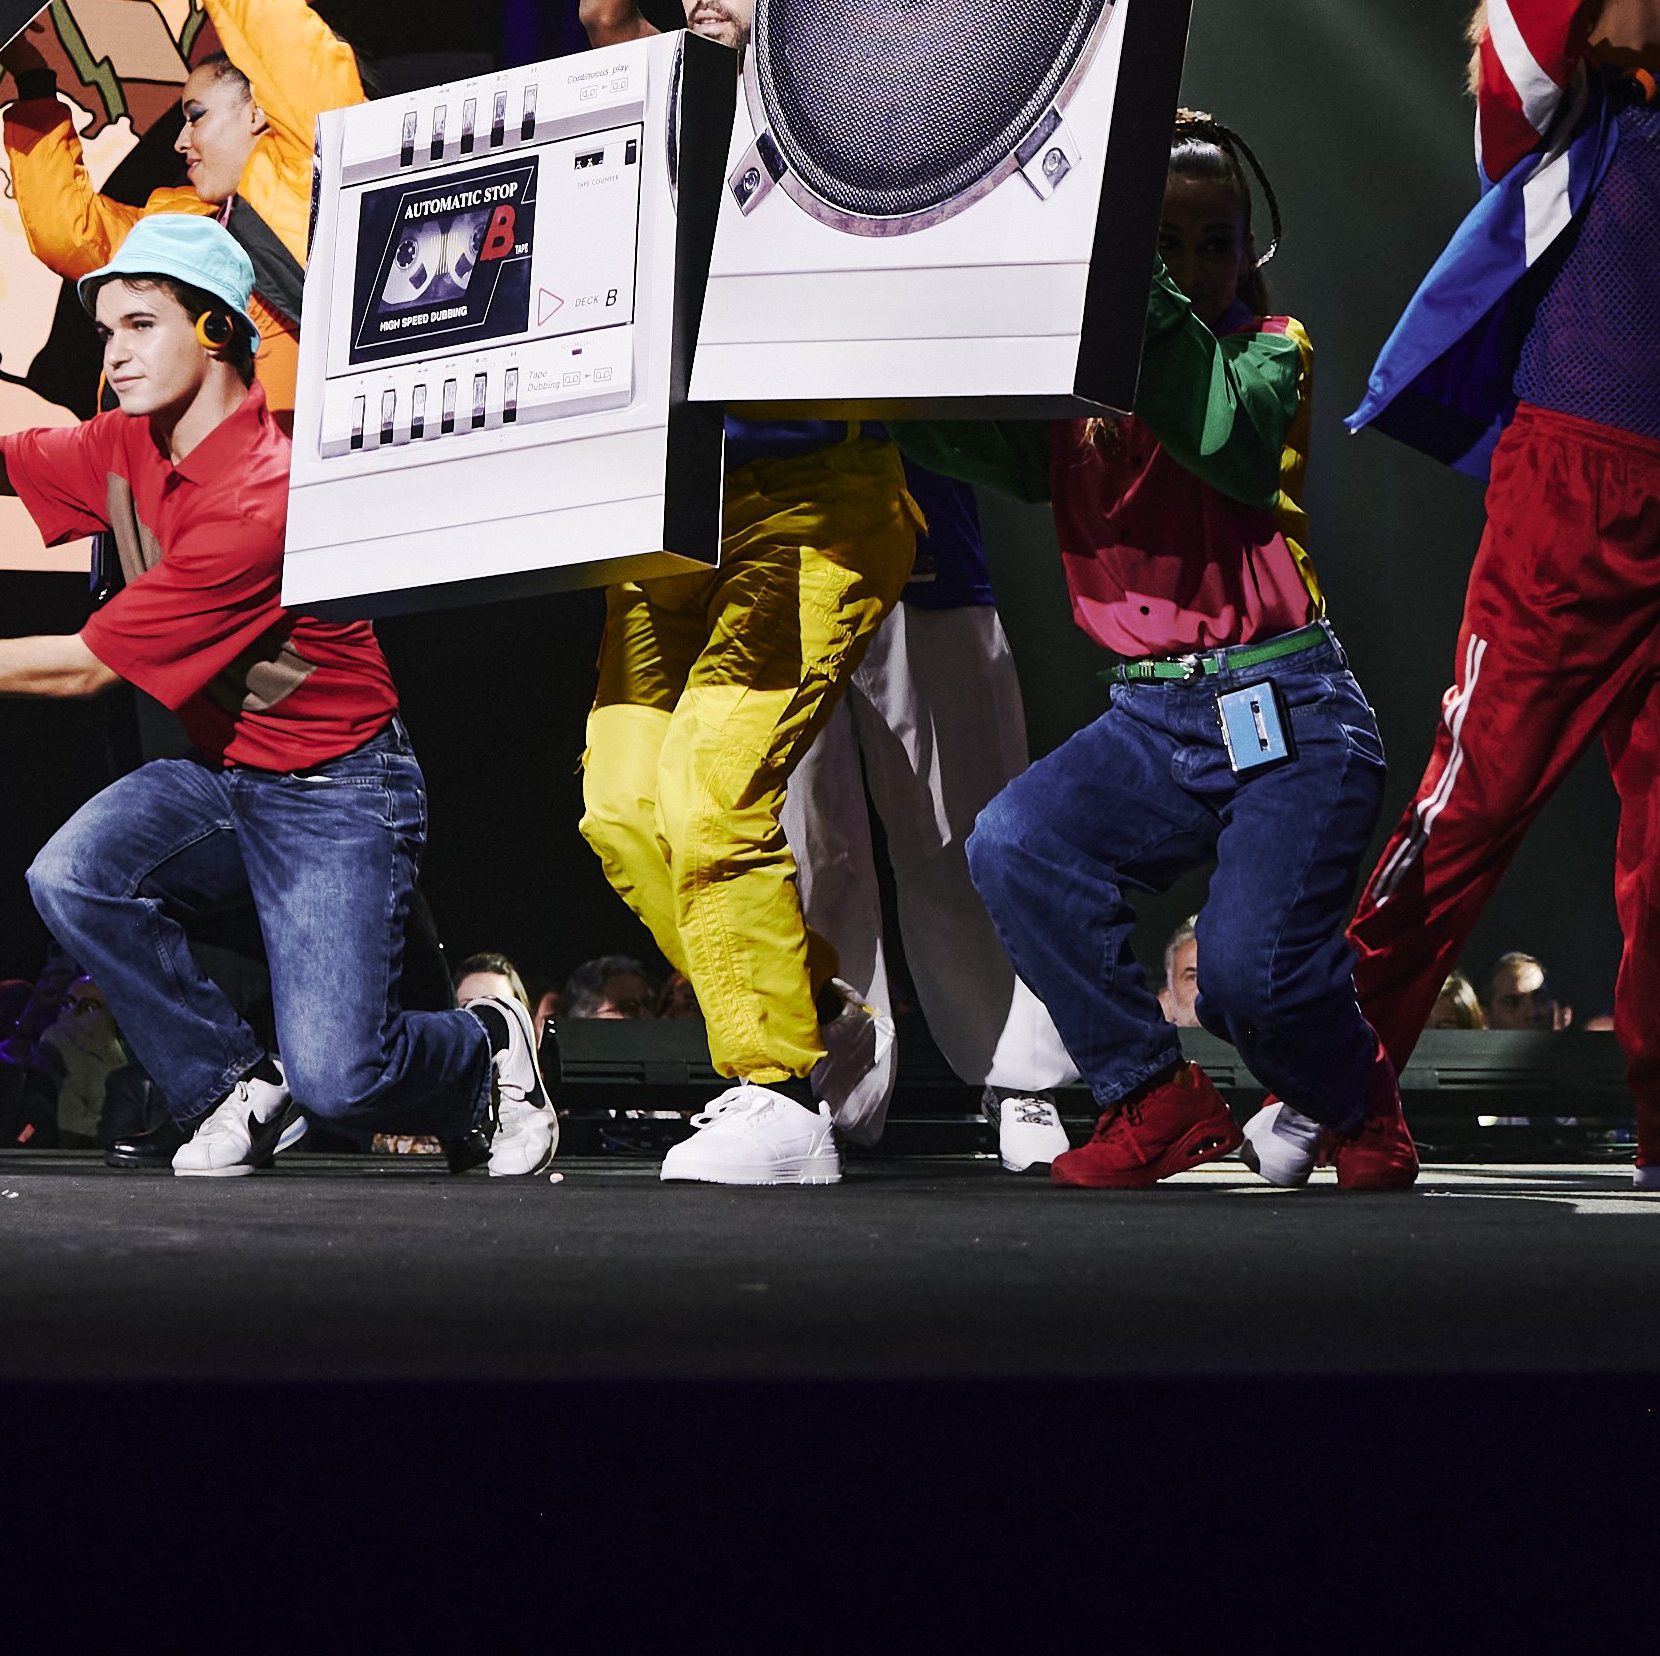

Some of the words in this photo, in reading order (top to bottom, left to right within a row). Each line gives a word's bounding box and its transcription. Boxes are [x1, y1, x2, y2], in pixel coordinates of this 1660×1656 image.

[567, 67, 609, 84] Continuous
[611, 63, 630, 76] play
[592, 174, 619, 186] COUNTER
[404, 189, 482, 220] AUTOMATIC
[483, 181, 518, 203] STOP
[479, 204, 516, 262] B
[514, 242, 529, 255] TAPE
[574, 294, 600, 308] DECK
[605, 288, 618, 307] B
[379, 318, 401, 332] HIGH
[401, 313, 429, 328] SPEED
[430, 305, 468, 323] DUBBING
[529, 370, 548, 380] Tape
[527, 380, 561, 393] Dubbing
